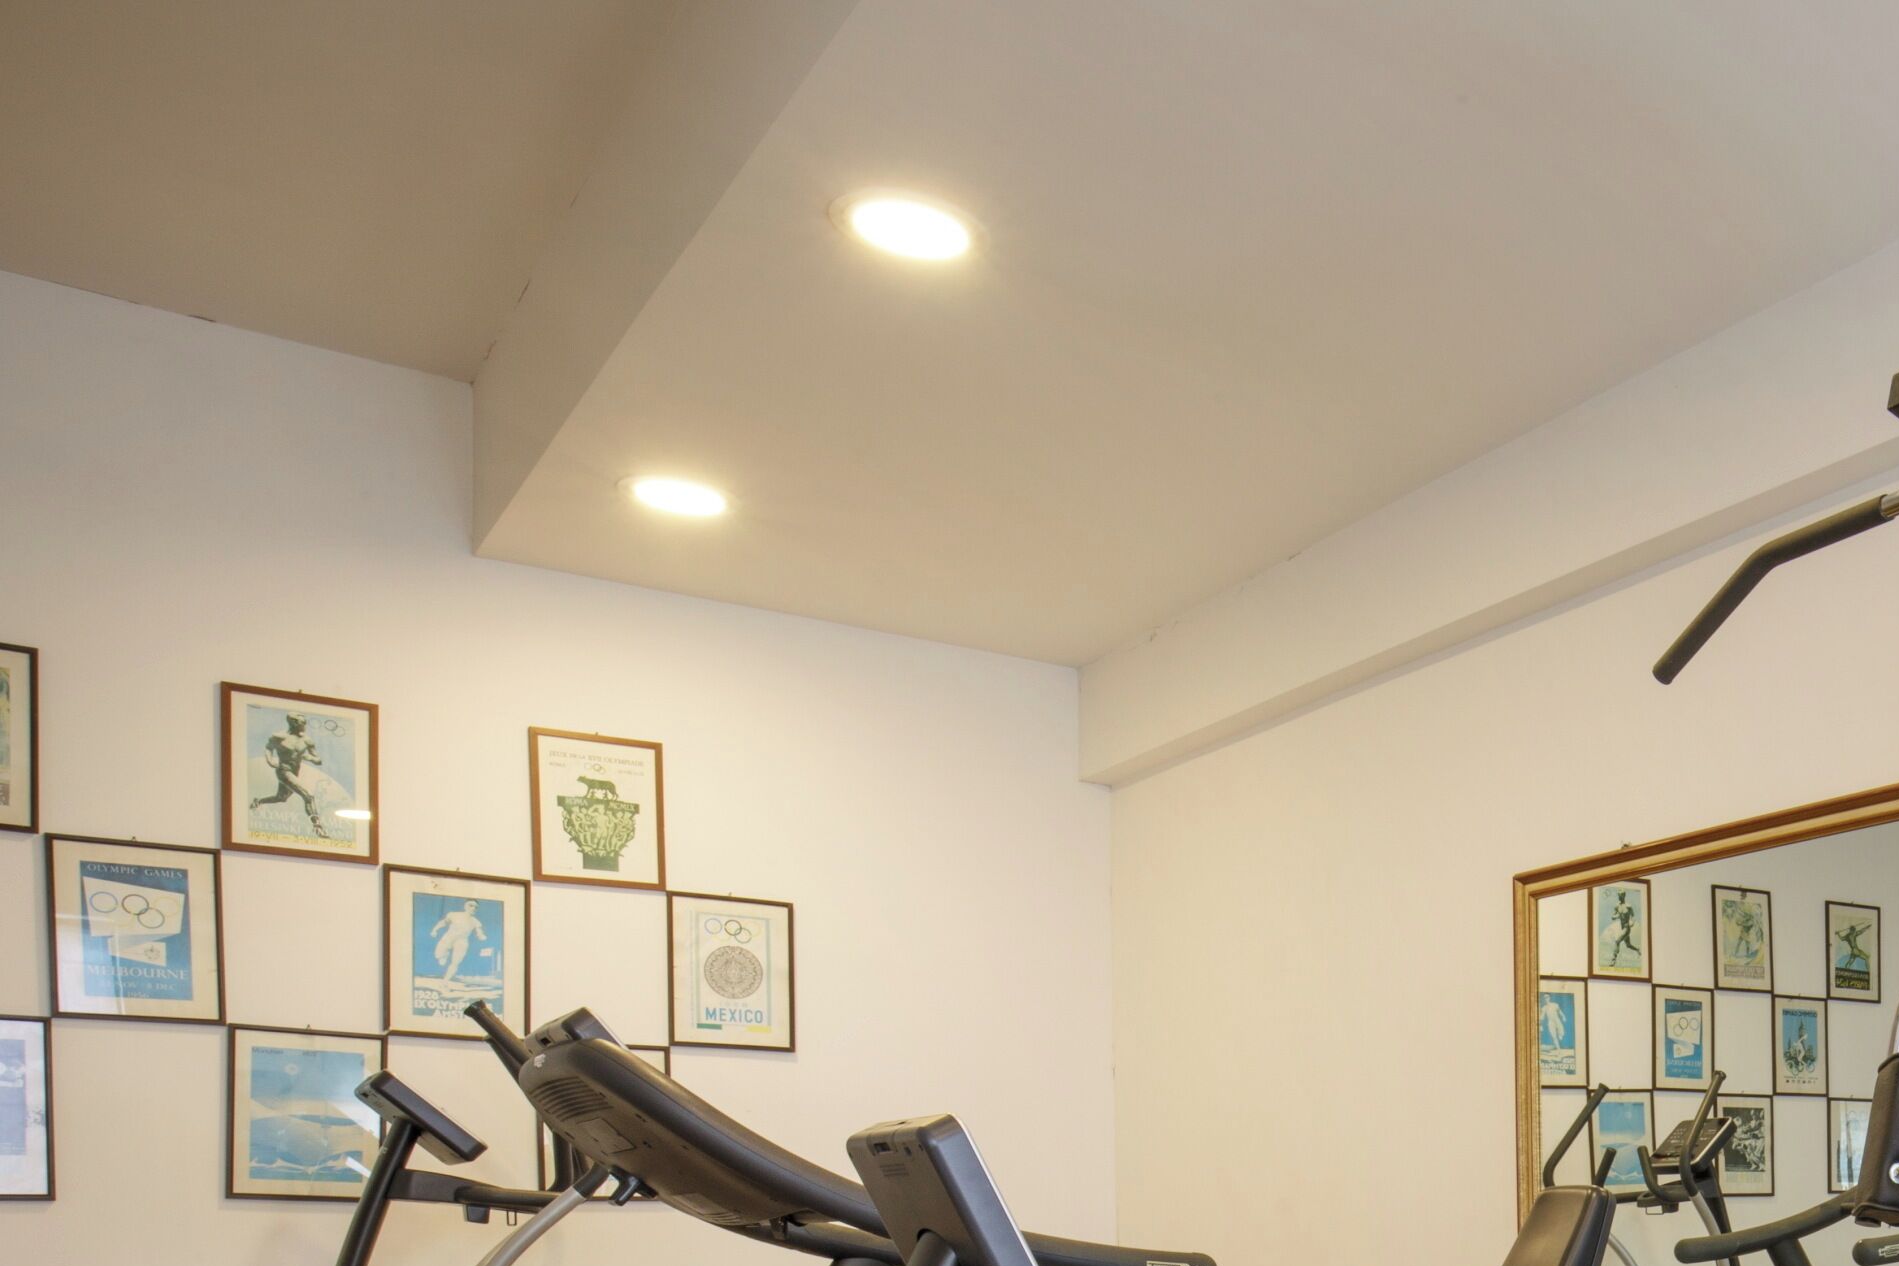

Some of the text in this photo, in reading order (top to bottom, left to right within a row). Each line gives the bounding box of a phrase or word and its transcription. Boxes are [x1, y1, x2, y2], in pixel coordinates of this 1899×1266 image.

[86, 863, 183, 879] OLYMPIC GAMES
[87, 965, 188, 980] MELBOURNE
[704, 1007, 764, 1024] MEXICO
